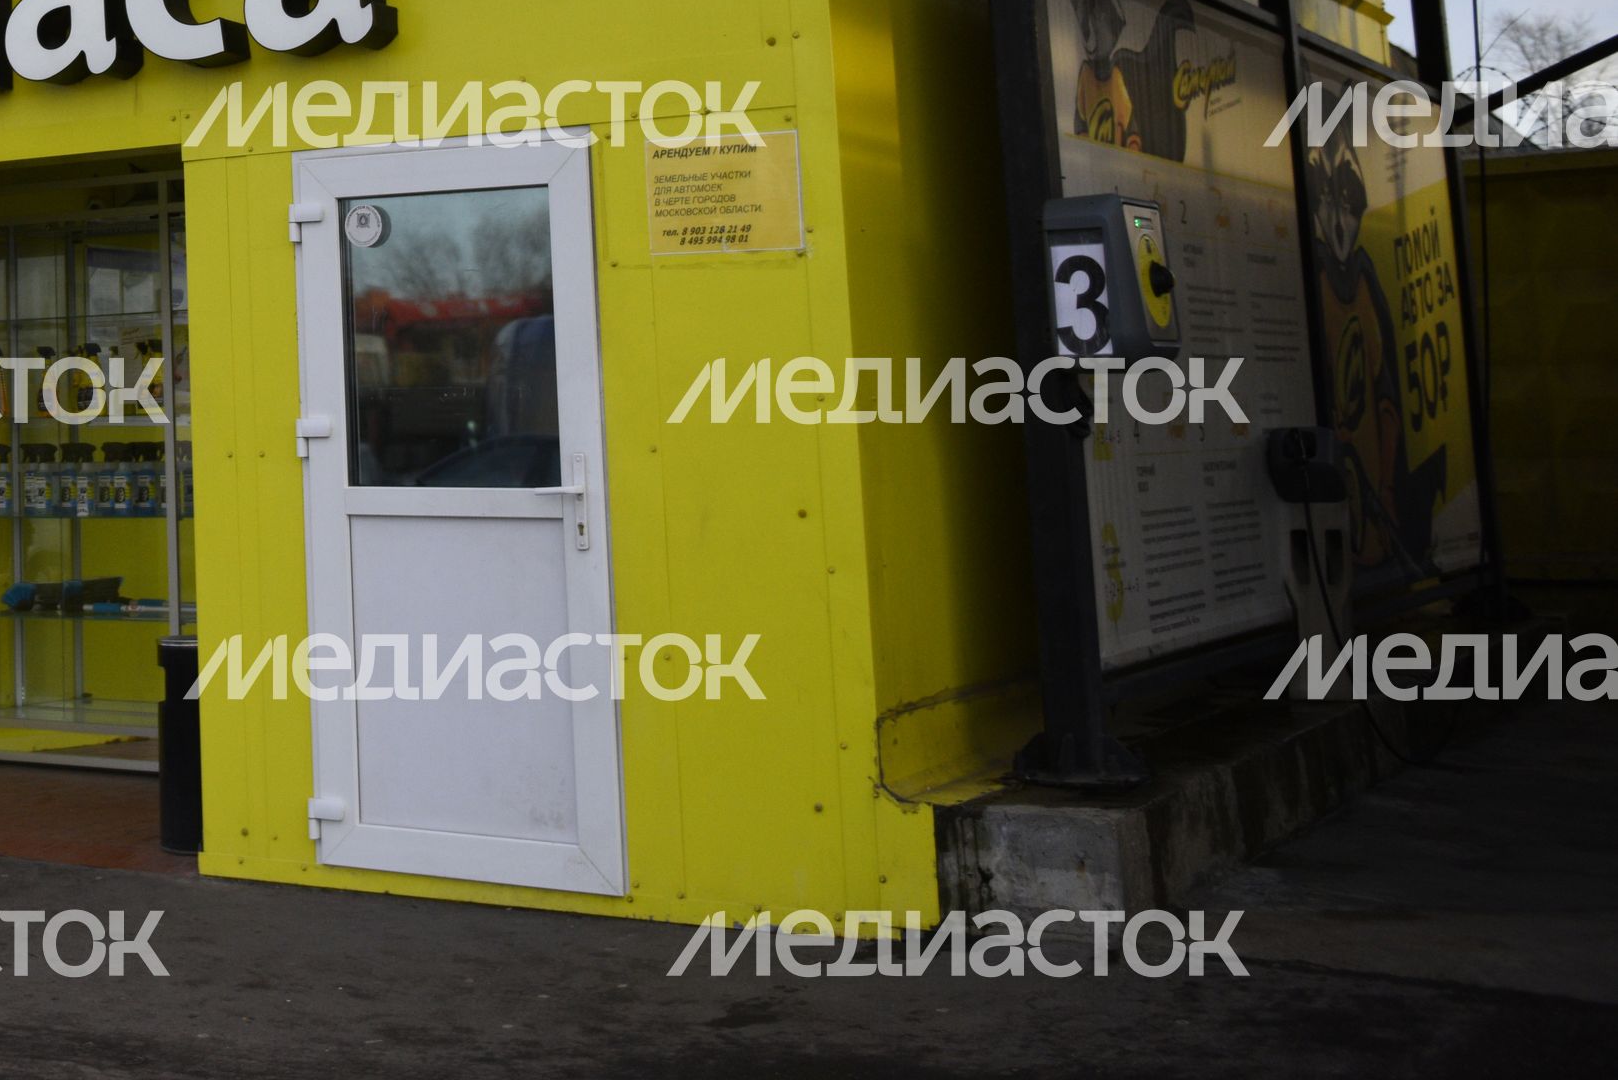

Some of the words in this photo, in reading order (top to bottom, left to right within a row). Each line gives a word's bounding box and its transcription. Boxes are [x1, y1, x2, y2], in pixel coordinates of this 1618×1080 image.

[652, 146, 711, 160] АРЕНДУЕМ
[719, 143, 757, 155] КУПИМ
[654, 172, 708, 184] ЗЕМЕЛЬНЫЕ
[710, 170, 751, 181] УЧАСТКИ
[653, 185, 672, 196] ДЛЯ
[674, 183, 723, 194] АВТОМОЕК
[662, 195, 691, 206] ЧЕРТЕ
[693, 193, 736, 204] ГОРОДОВ
[655, 206, 717, 217] МОСКОВСКОЙ
[719, 204, 761, 215] ОБЛАСТИ
[662, 229, 679, 237] тел.
[689, 226, 706, 235] 903
[726, 224, 738, 234] 21
[687, 236, 704, 245] 495
[724, 234, 736, 244] 98
[737, 234, 749, 243] 01
[1394, 205, 1441, 281] ПОМОЙ
[1400, 272, 1434, 330] АВТО
[1435, 261, 1455, 306] ЗА
[1055, 255, 1112, 356] 3
